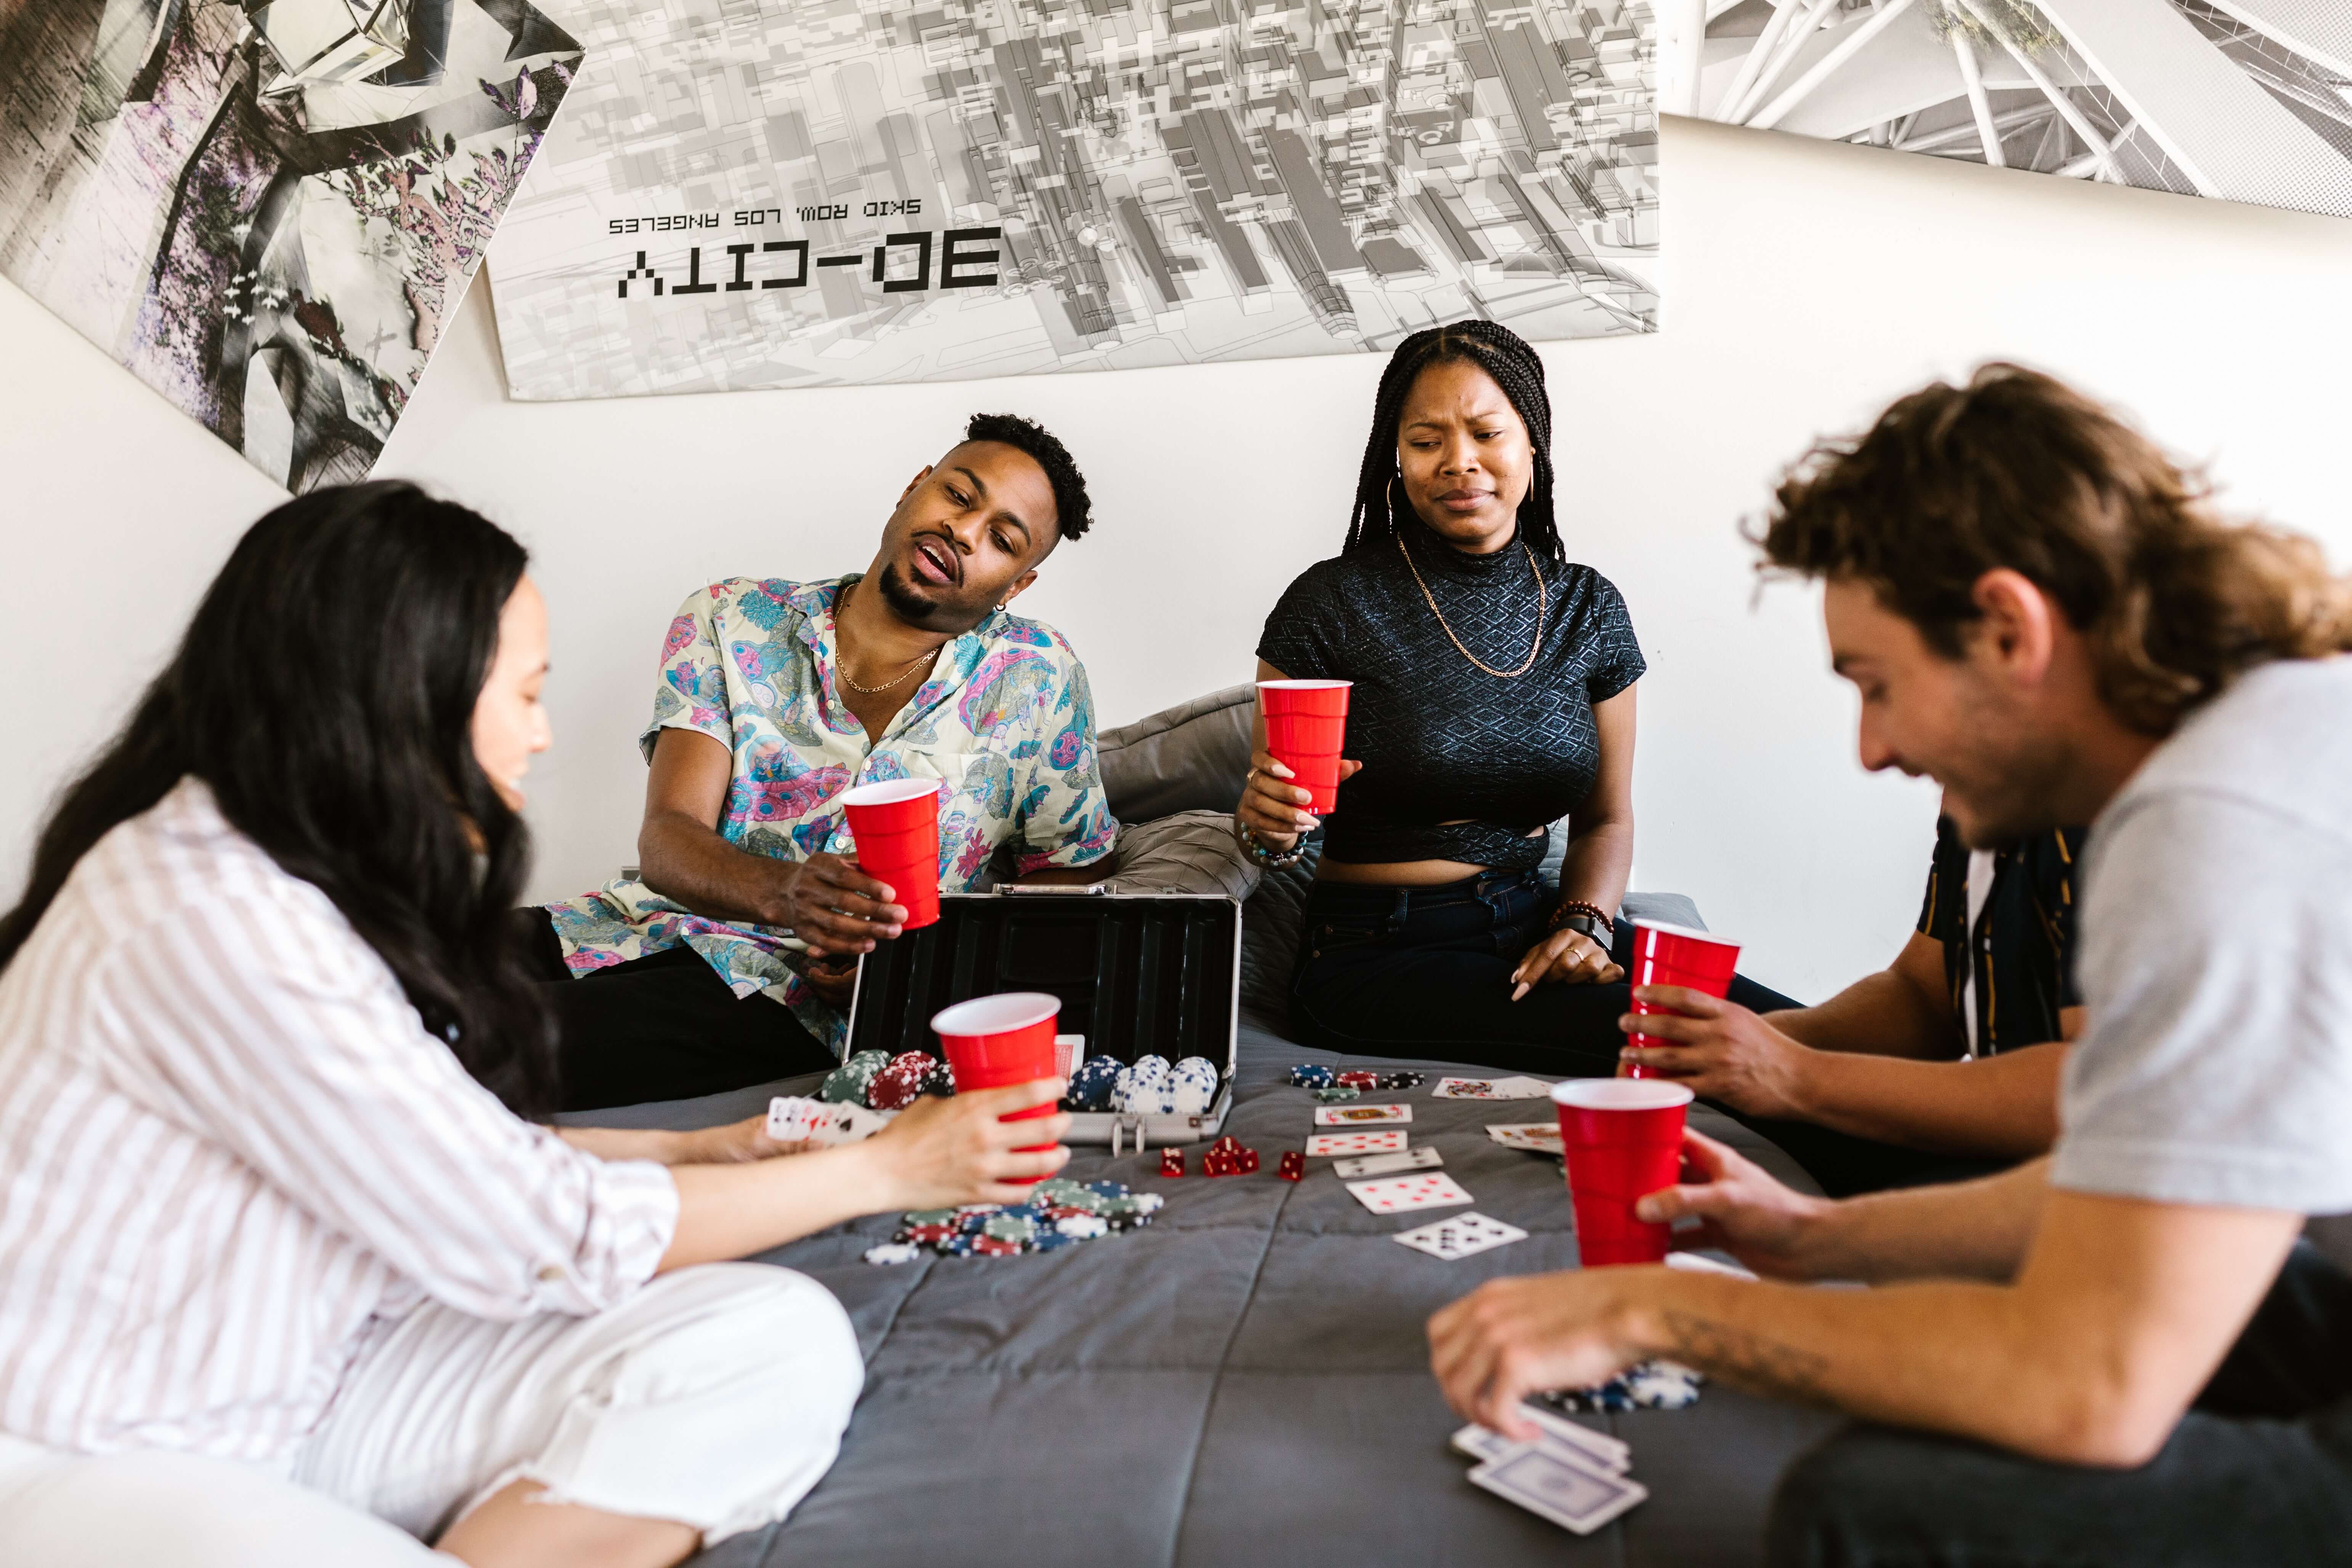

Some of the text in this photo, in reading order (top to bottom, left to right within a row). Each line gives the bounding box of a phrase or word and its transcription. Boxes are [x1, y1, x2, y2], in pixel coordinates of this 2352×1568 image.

[609, 199, 921, 234] SKID ROW, LOS ANGELES
[618, 226, 1002, 298] 3D-CITY
